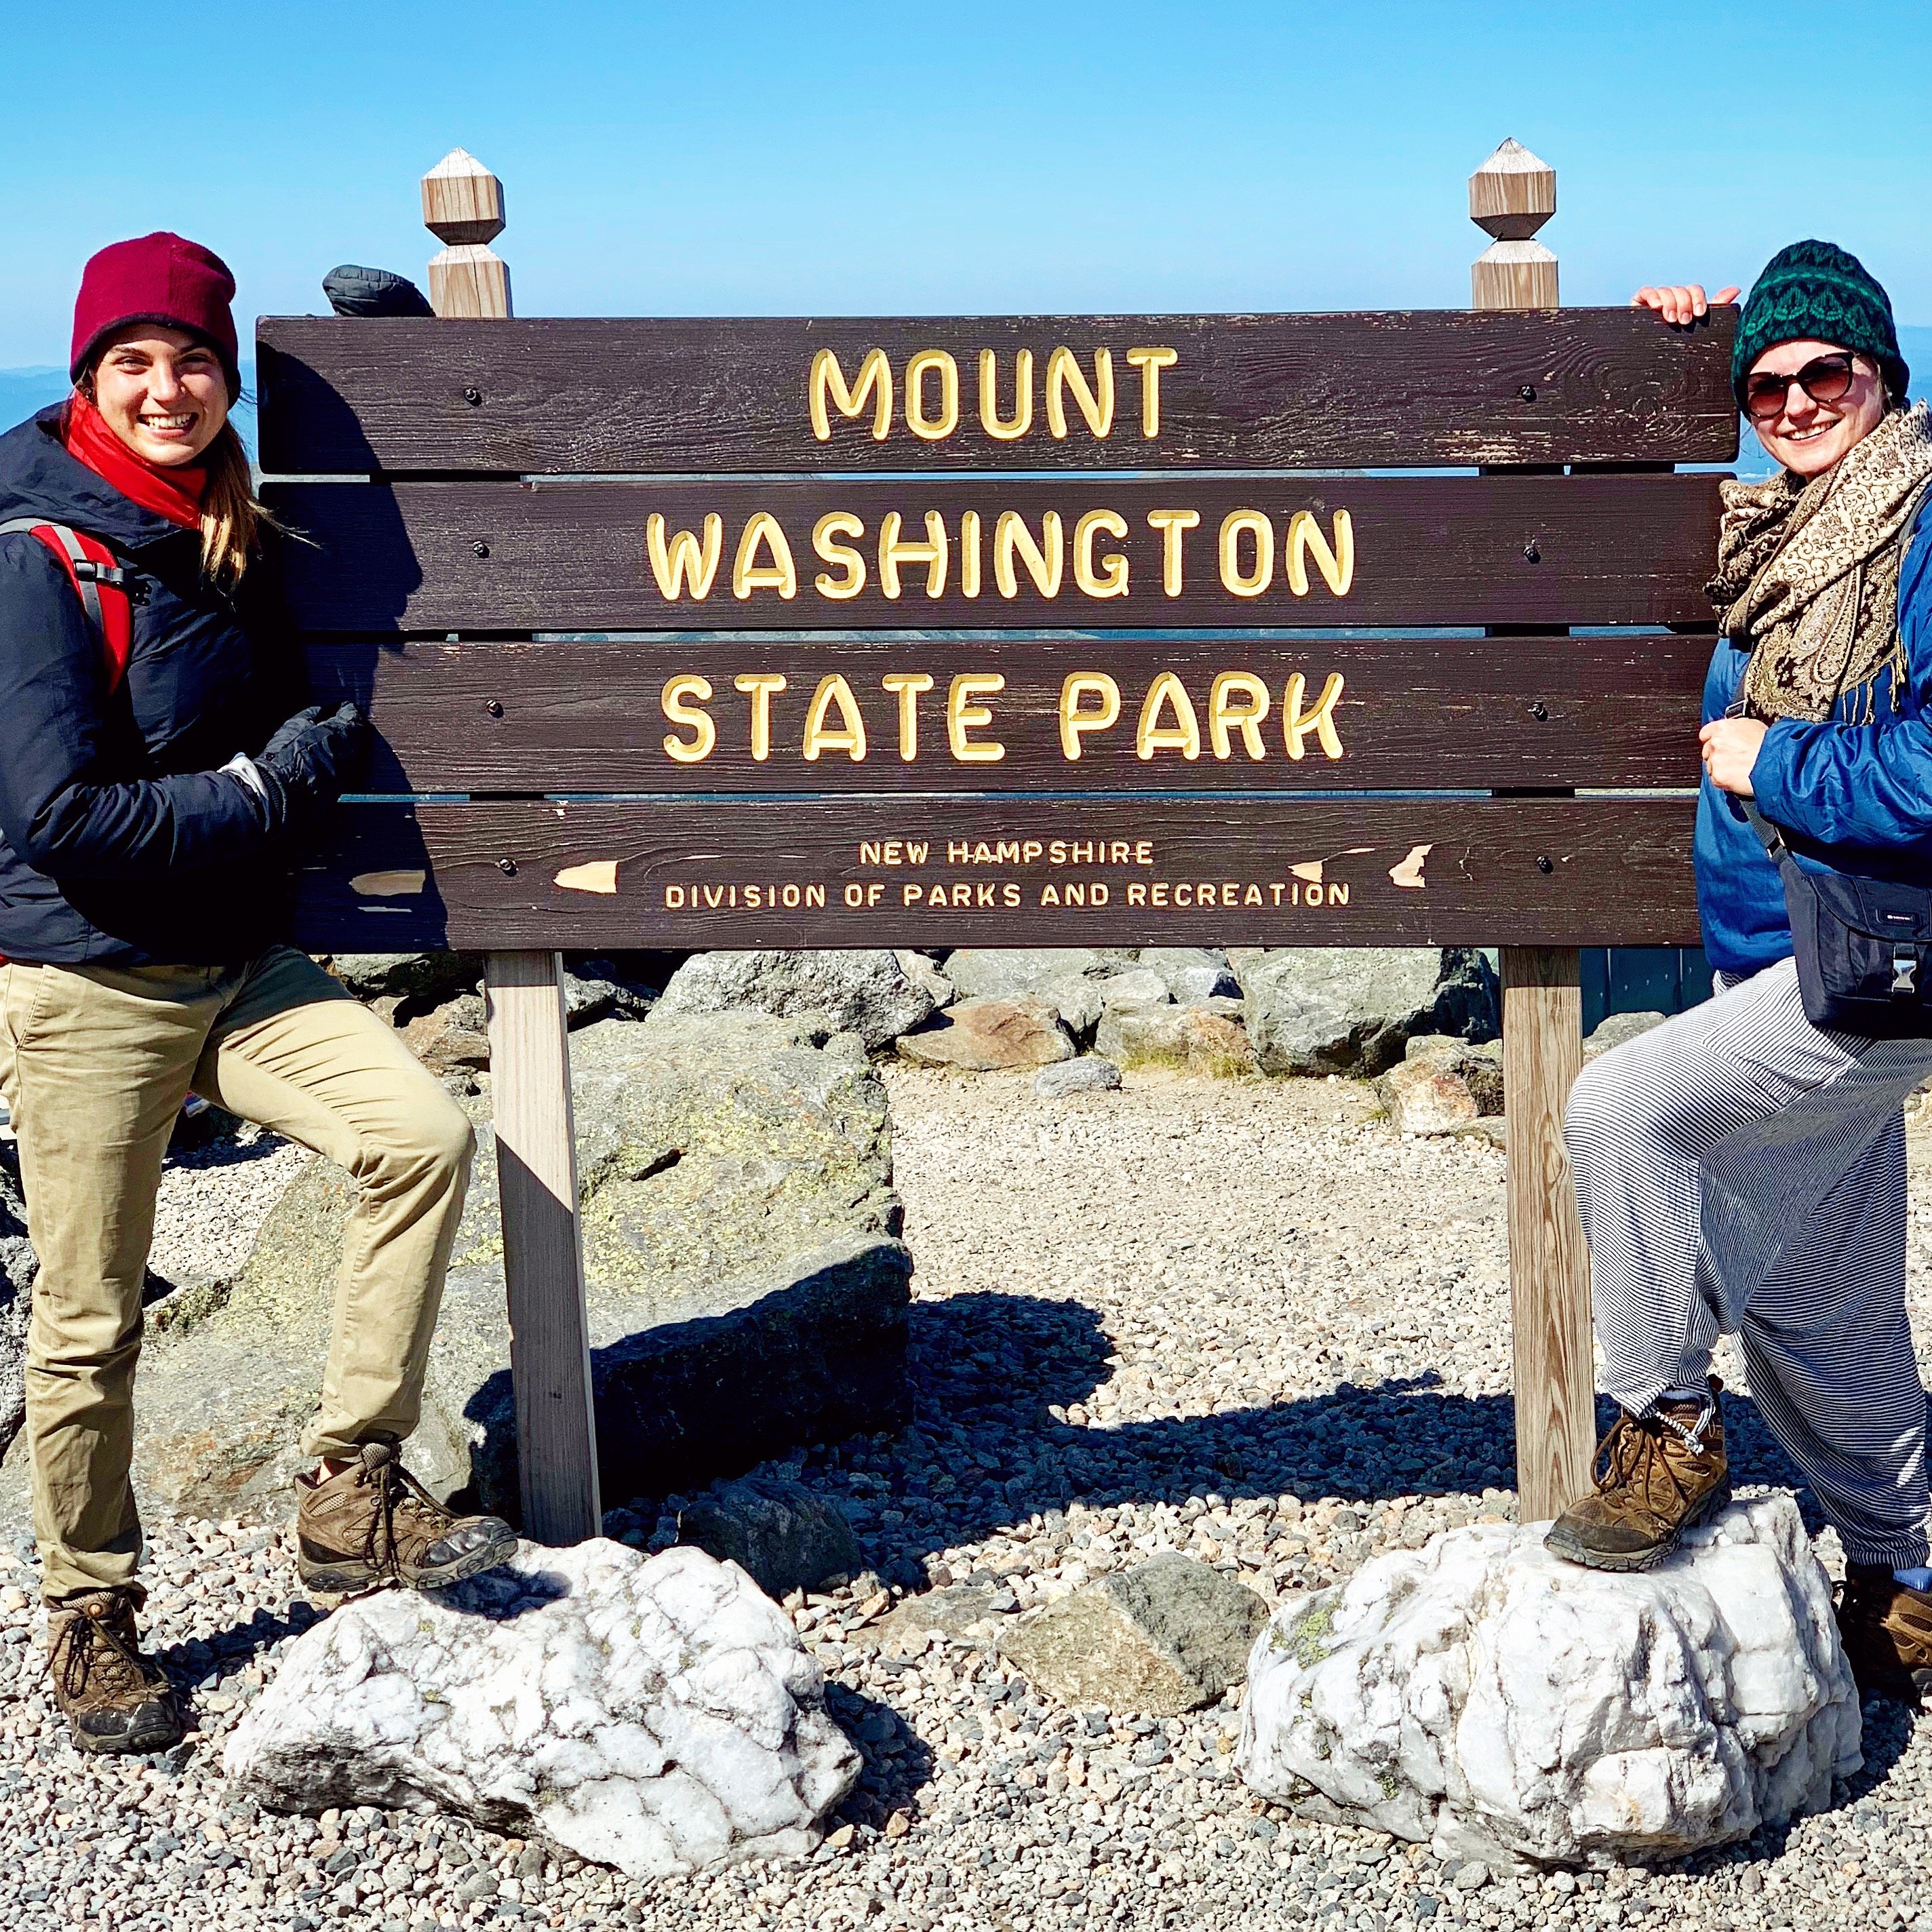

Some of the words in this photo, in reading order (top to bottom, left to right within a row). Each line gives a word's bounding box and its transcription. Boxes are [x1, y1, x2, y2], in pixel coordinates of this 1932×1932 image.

[808, 346, 1179, 441] MOUNT
[646, 508, 1355, 602] WASHINGTON
[661, 672, 1006, 763] STATE
[1060, 670, 1345, 762] PARK
[665, 884, 826, 909] DIVISION
[844, 883, 886, 908] OF
[903, 882, 1021, 908] PARKS
[1040, 882, 1109, 907] AND
[1126, 882, 1349, 907] RECREATION
[859, 840, 930, 865] NEW
[946, 840, 1154, 865] HAMPSHIRE
